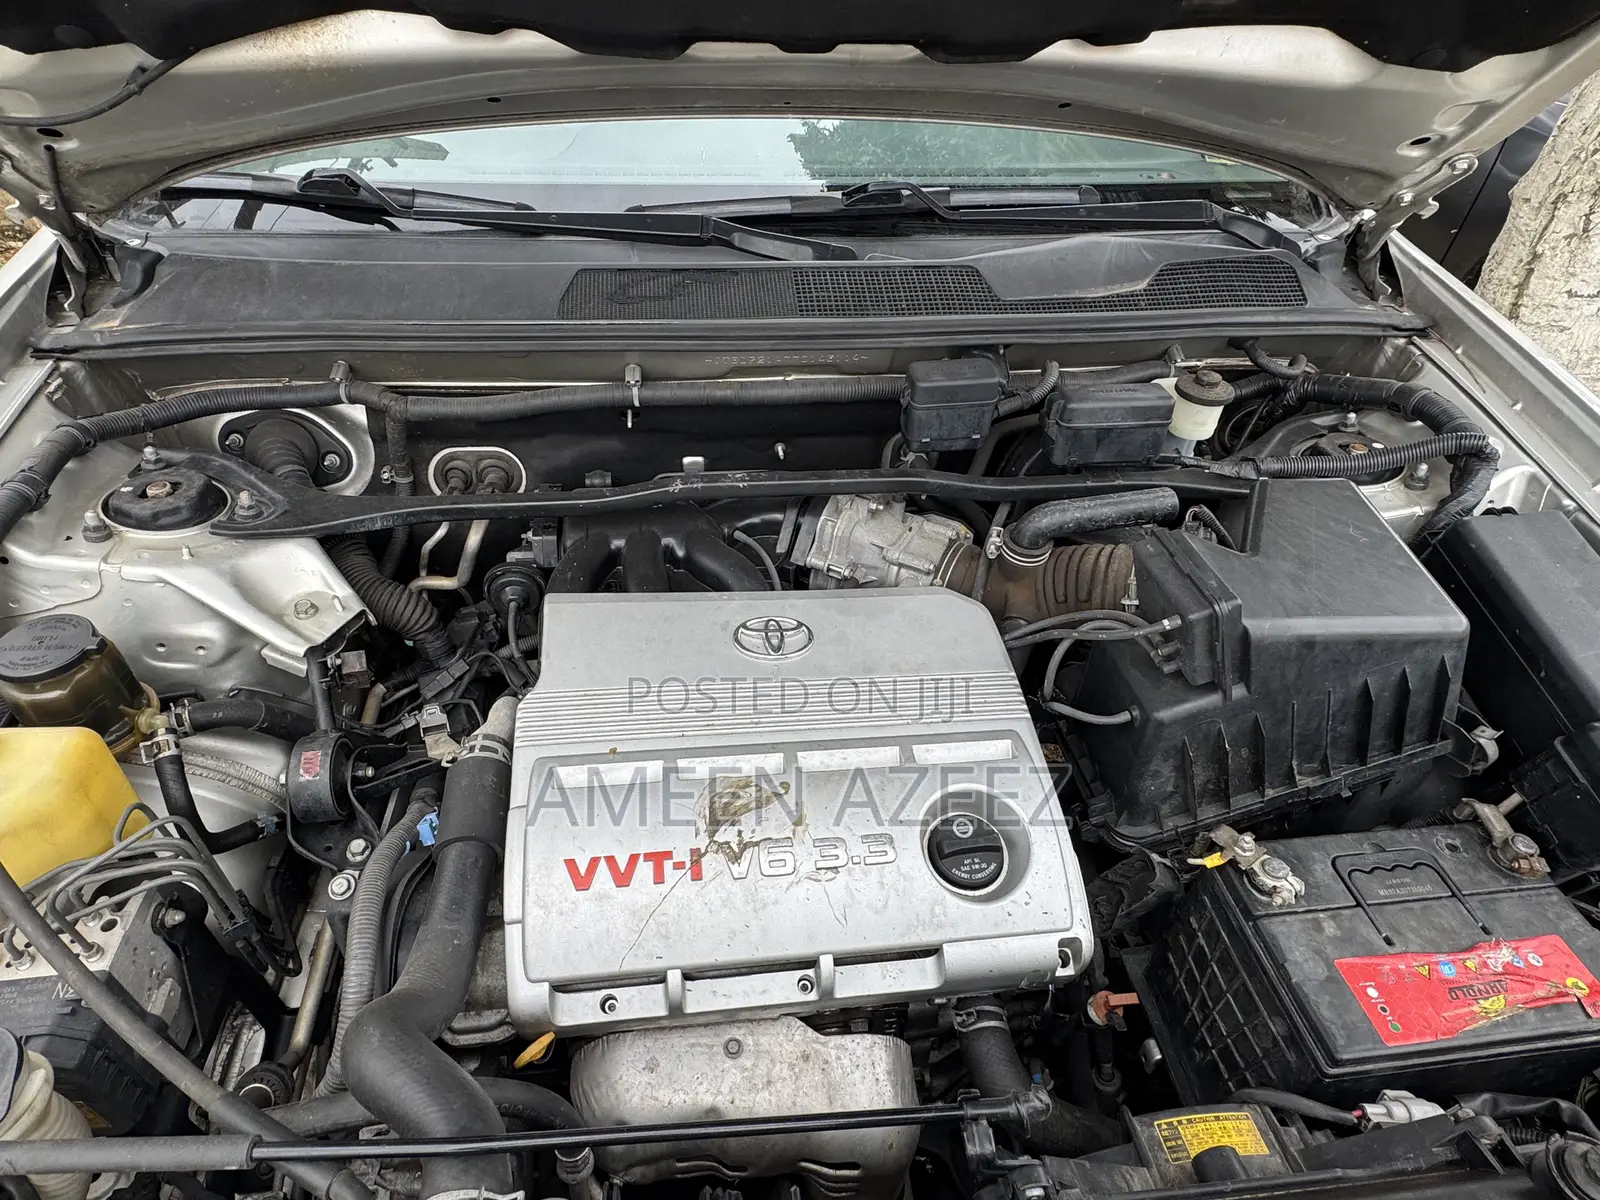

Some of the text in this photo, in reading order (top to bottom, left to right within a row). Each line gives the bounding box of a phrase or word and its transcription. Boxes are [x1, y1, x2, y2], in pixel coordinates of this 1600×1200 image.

[723, 837, 797, 881] V6
[812, 832, 898, 871] 3.3
[952, 862, 997, 879] ENERGY CONSERVING
[1448, 980, 1508, 1000] ARNOLD
